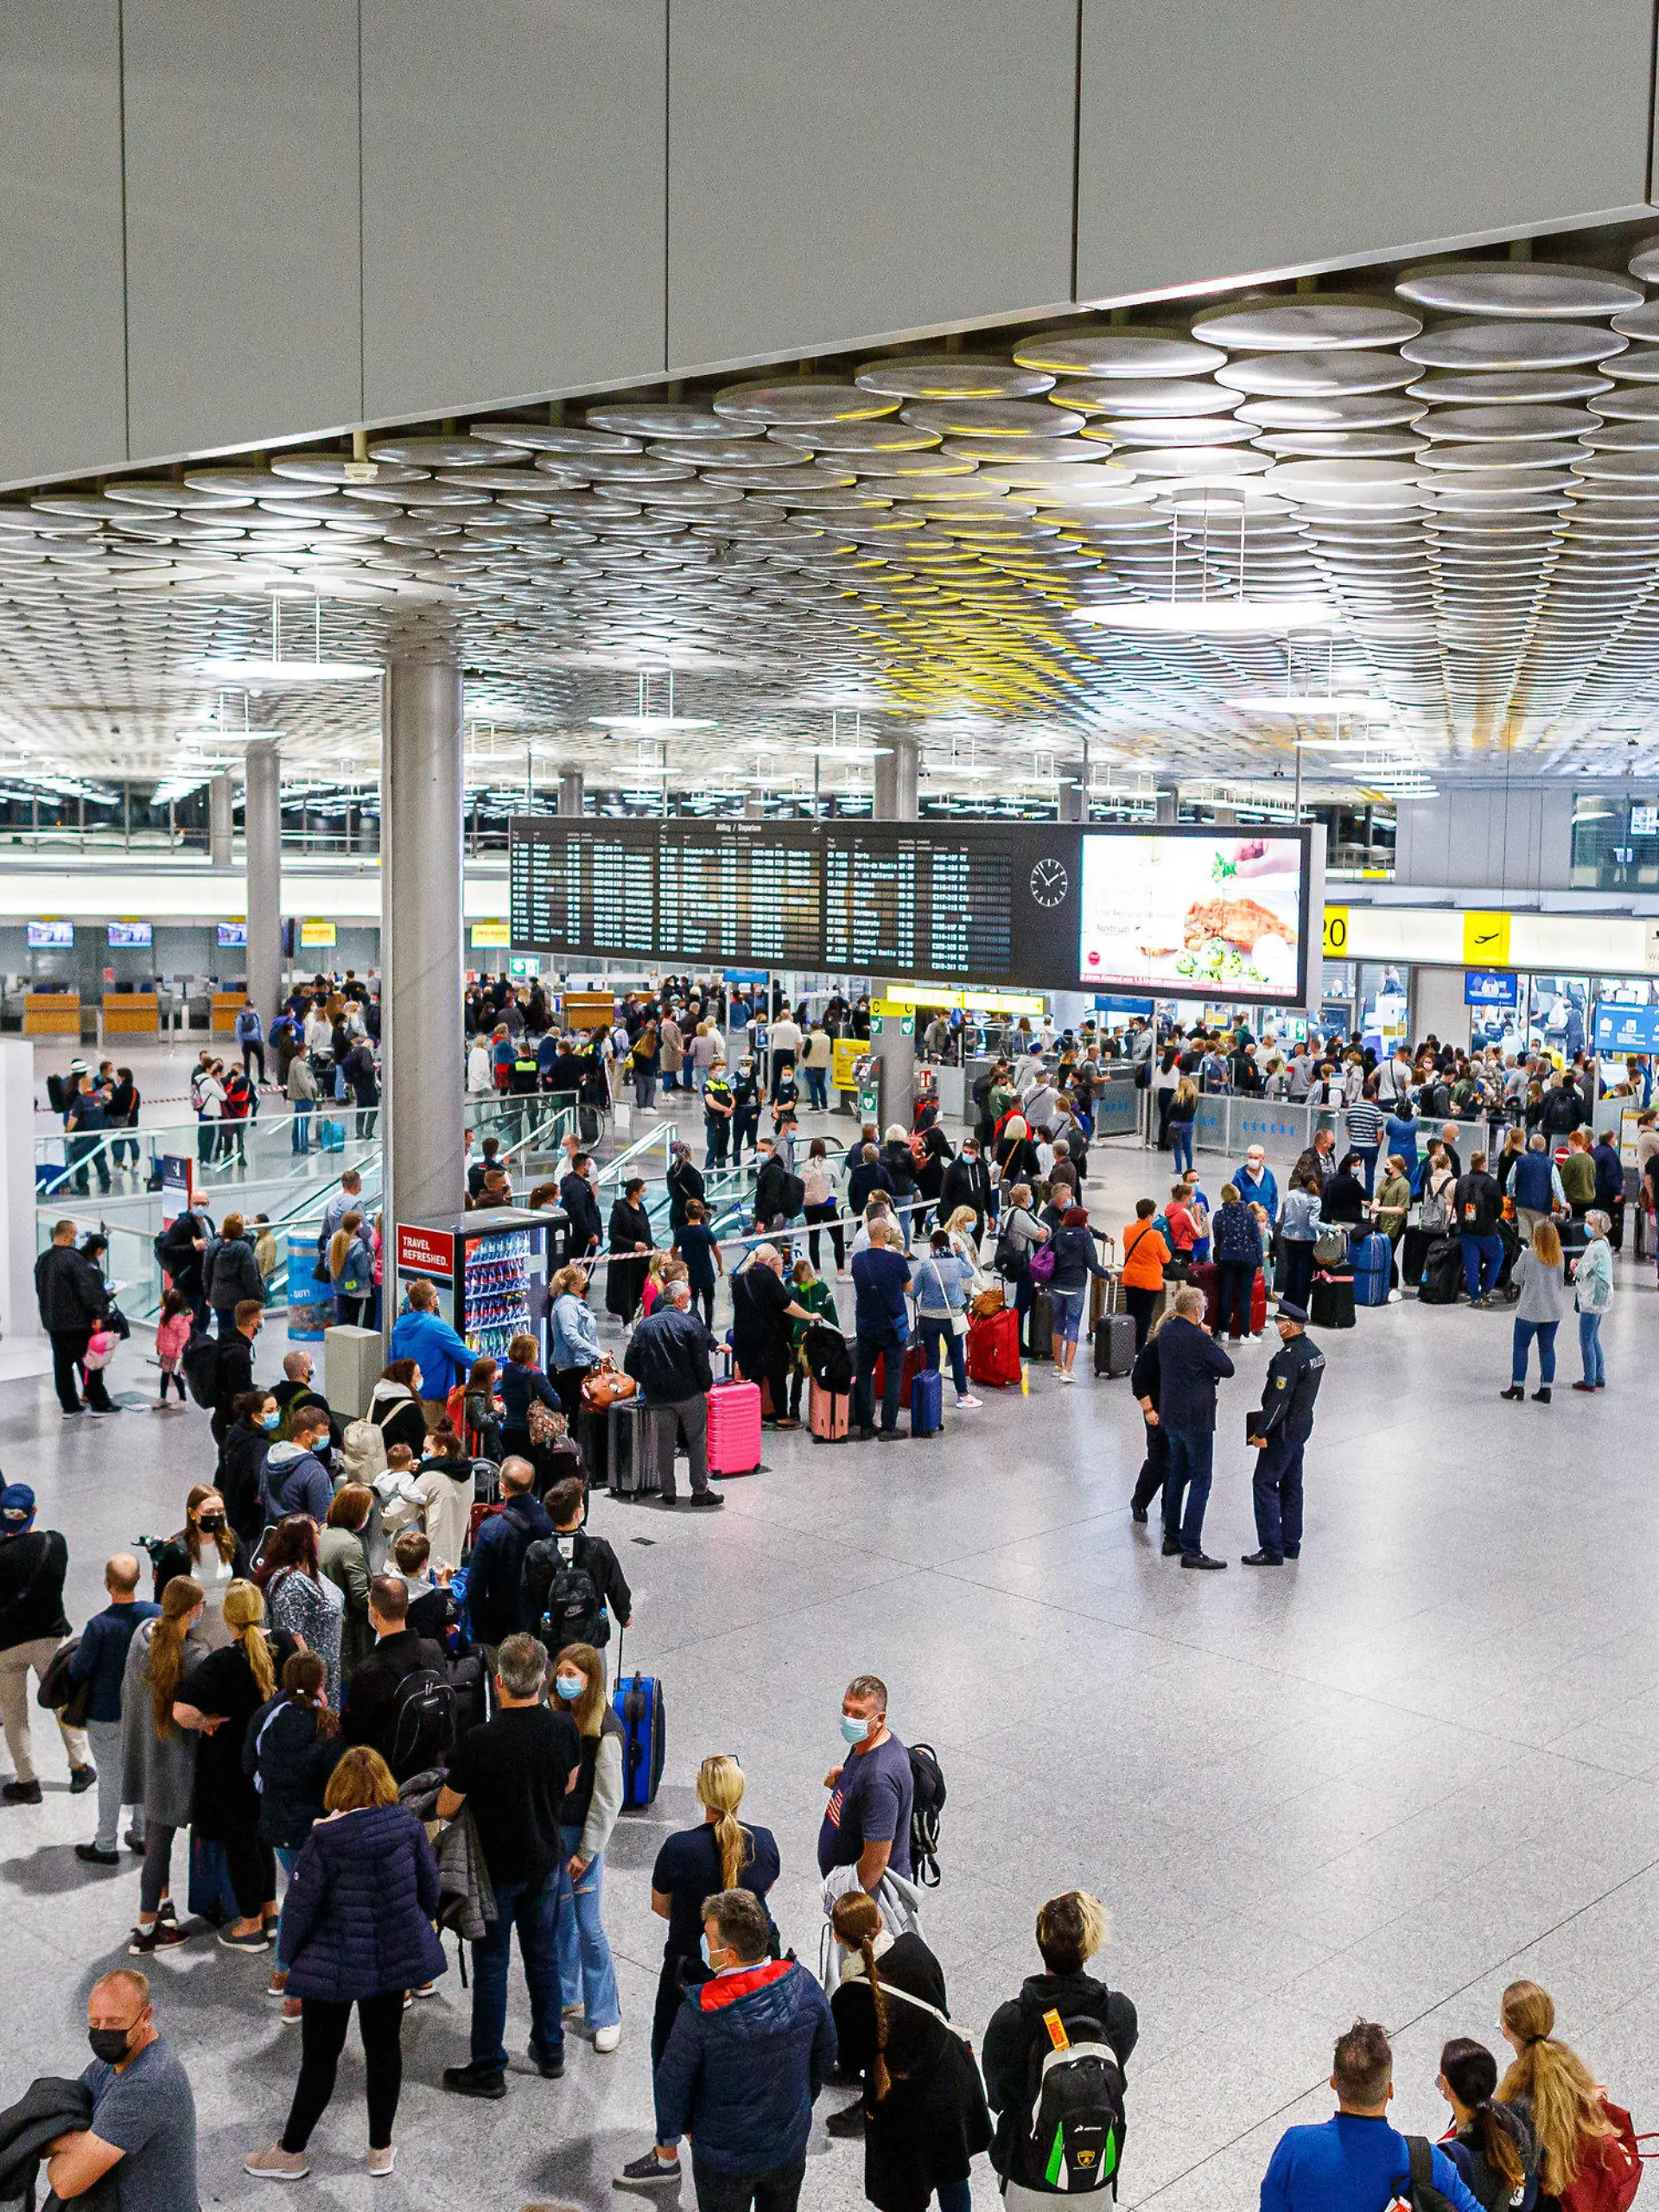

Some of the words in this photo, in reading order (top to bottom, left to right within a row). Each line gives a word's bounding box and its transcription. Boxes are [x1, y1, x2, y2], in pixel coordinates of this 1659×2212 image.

[1323, 918, 1346, 947] 0
[873, 1001, 880, 1013] C
[402, 1236, 431, 1251] TRAVEL
[403, 1249, 449, 1267] REFRESHED.
